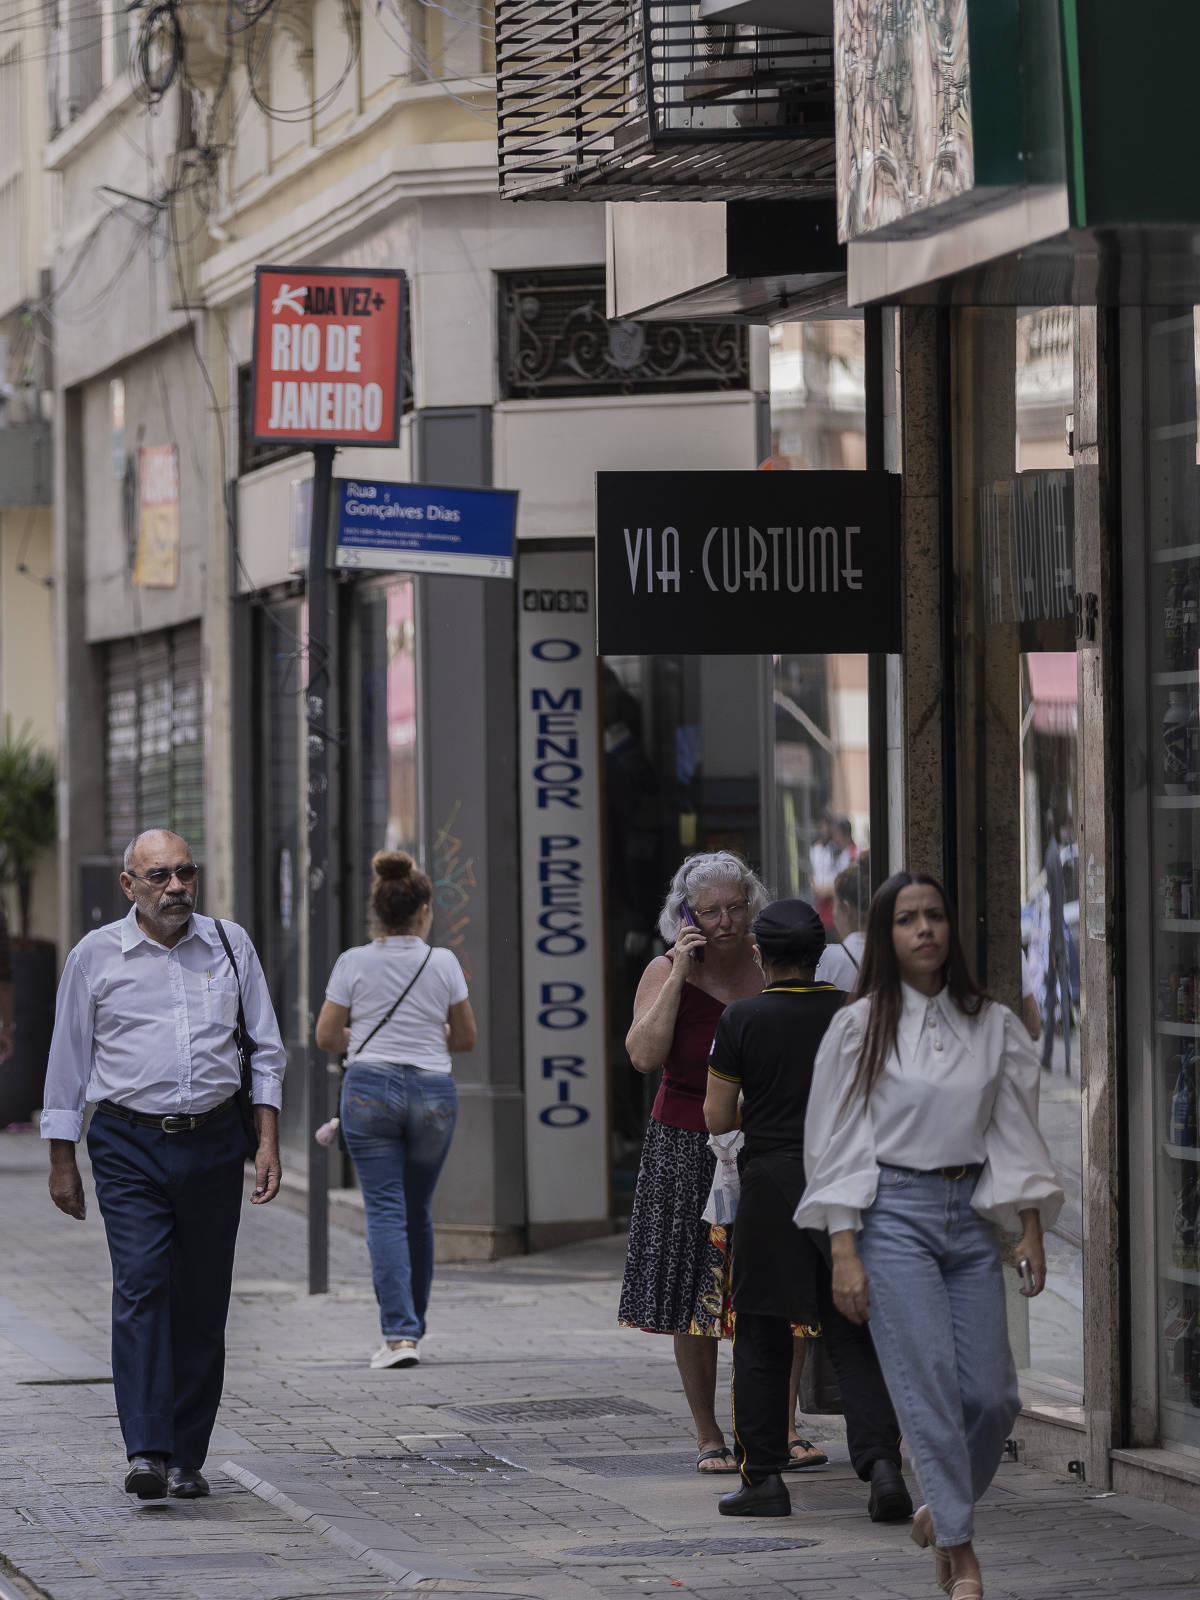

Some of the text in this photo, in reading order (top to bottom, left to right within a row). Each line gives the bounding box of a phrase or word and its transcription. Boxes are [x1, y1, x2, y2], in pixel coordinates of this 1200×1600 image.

[270, 323, 362, 373] RIO DE
[268, 381, 383, 432] JANEIRO
[345, 500, 462, 523] Gonçalves Dias
[346, 482, 378, 499] Rua
[623, 526, 863, 596] VIA CURTUME
[531, 638, 581, 662] O
[531, 687, 583, 810] MENOR
[538, 982, 588, 1031] DO
[538, 1055, 591, 1128] RIO
